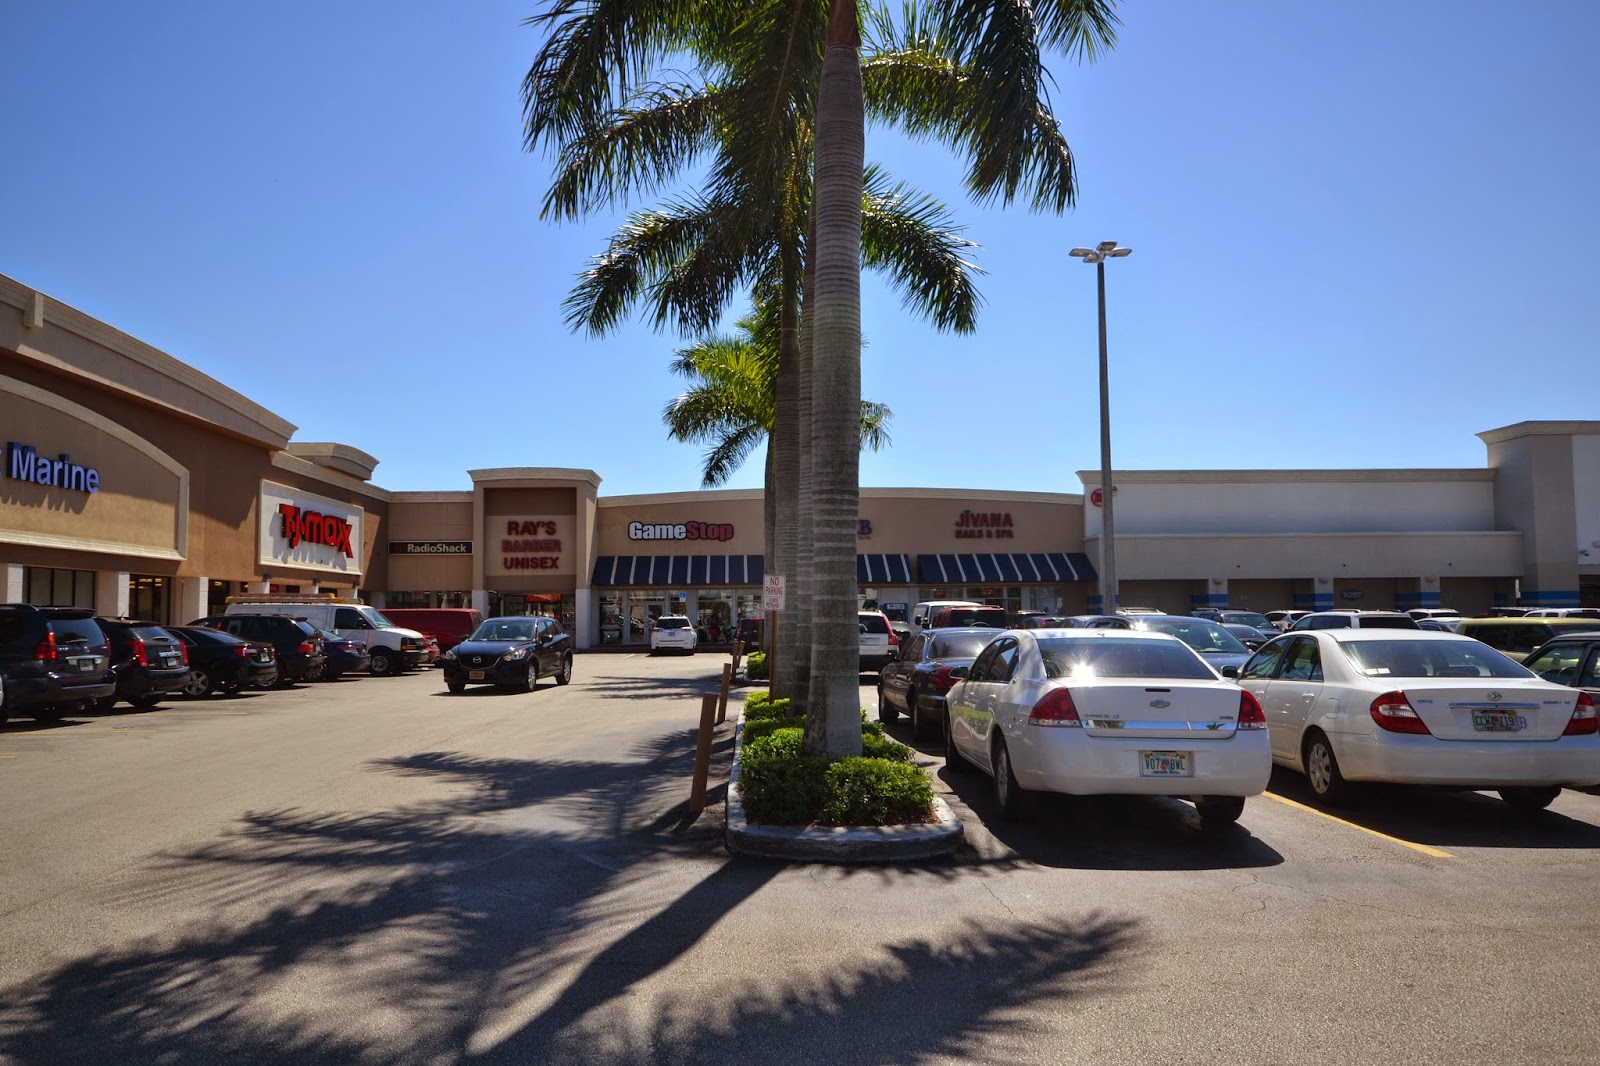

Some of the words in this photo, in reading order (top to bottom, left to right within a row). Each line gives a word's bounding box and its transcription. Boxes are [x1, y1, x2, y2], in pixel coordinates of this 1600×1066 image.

[8, 442, 100, 494] Marine
[507, 520, 557, 536] RAY'S
[628, 520, 735, 542] GameStop
[955, 529, 983, 539] NAILS
[985, 529, 993, 539] &
[995, 529, 1014, 539] SPA
[407, 543, 467, 554] RadioShack
[501, 539, 562, 553] BARBER
[503, 556, 560, 570] UNISEX
[770, 577, 780, 586] NO
[765, 586, 784, 596] PARKING
